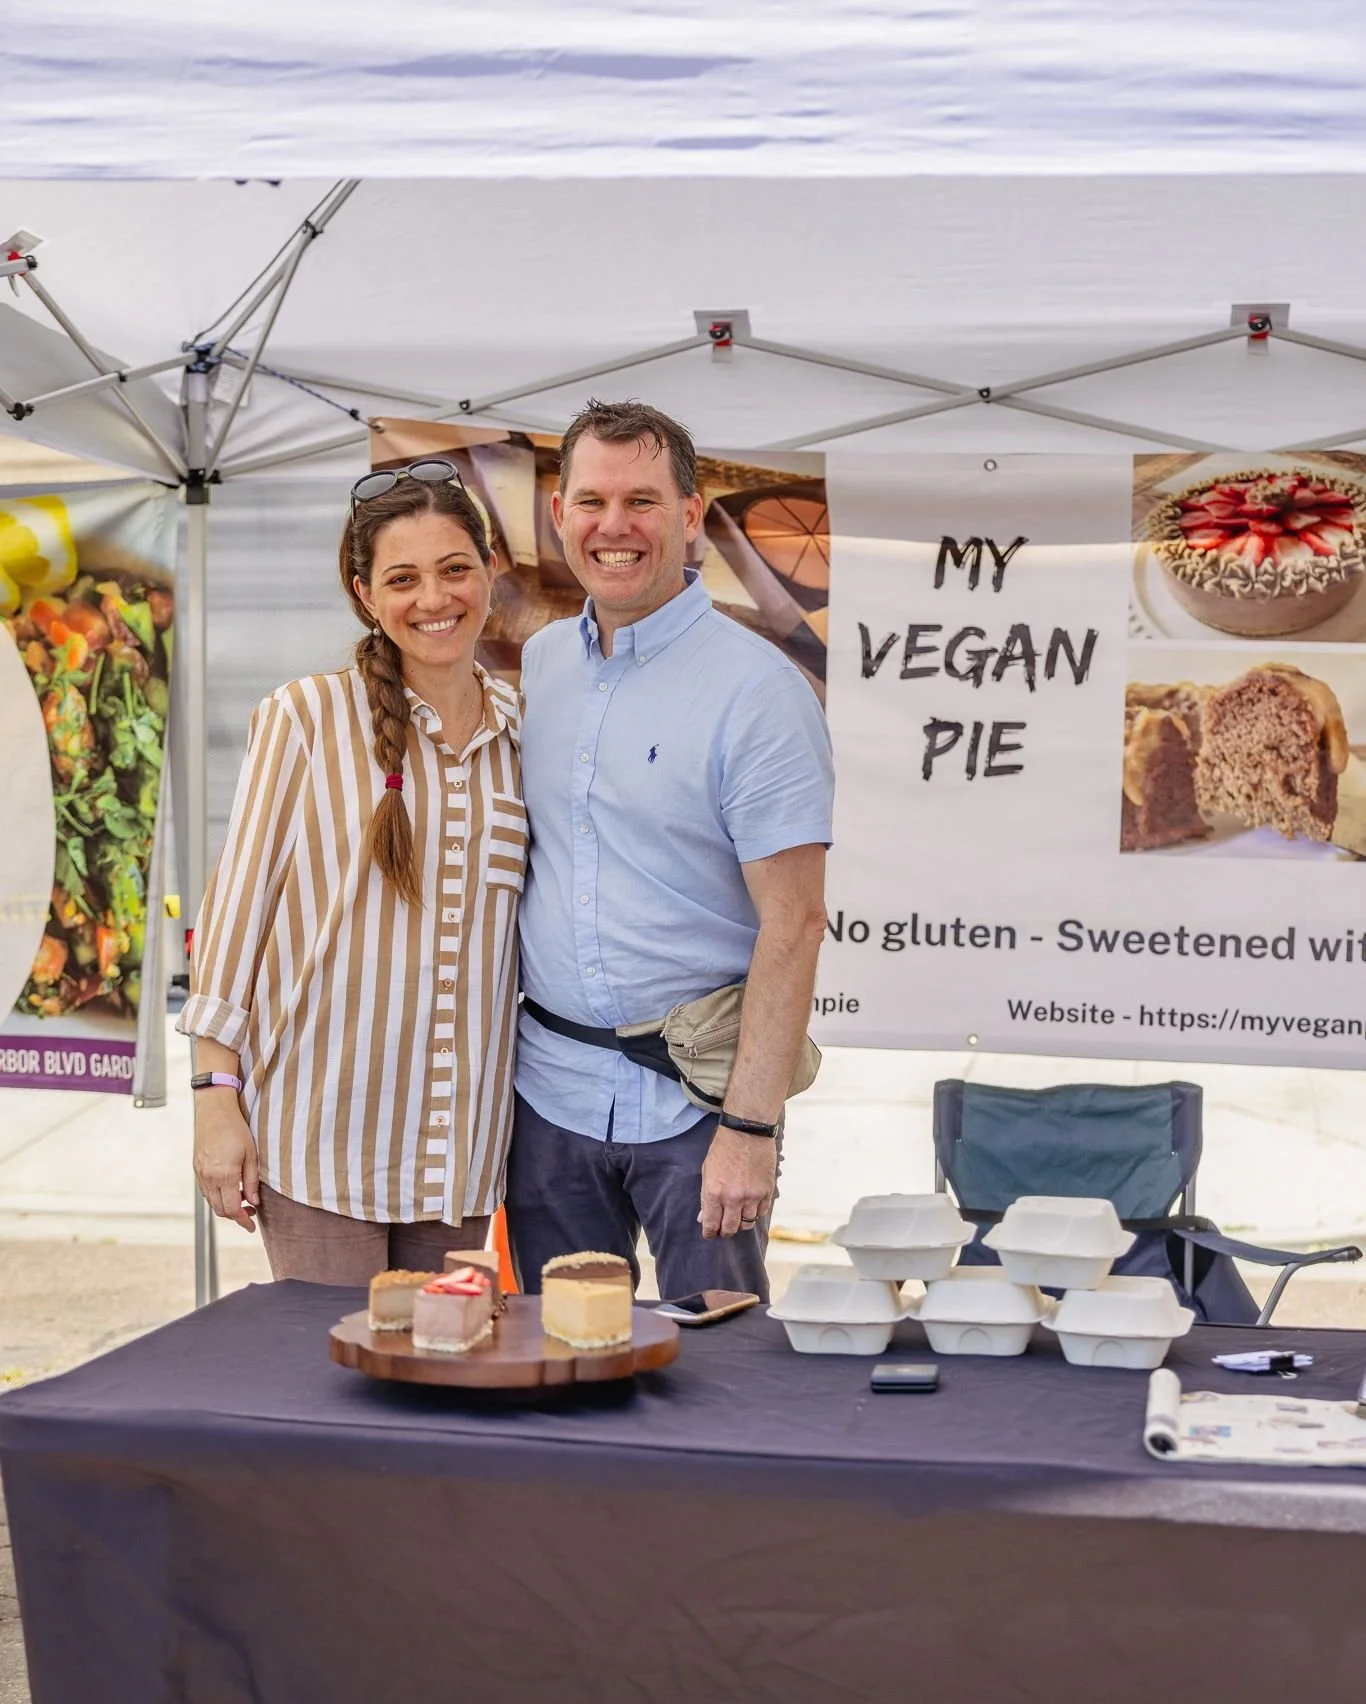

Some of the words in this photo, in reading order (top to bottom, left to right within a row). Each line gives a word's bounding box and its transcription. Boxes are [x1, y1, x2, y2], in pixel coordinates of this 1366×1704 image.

[934, 536, 1030, 593] MY
[858, 622, 1098, 693] VEGAN
[922, 716, 1027, 781] PIE
[826, 910, 870, 943] No
[881, 911, 1016, 951] gluten
[1056, 919, 1296, 961] Sweetened
[1007, 999, 1115, 1025] Website
[1139, 1004, 1366, 1040] https://myvegan
[44, 1050, 87, 1076] BLVD
